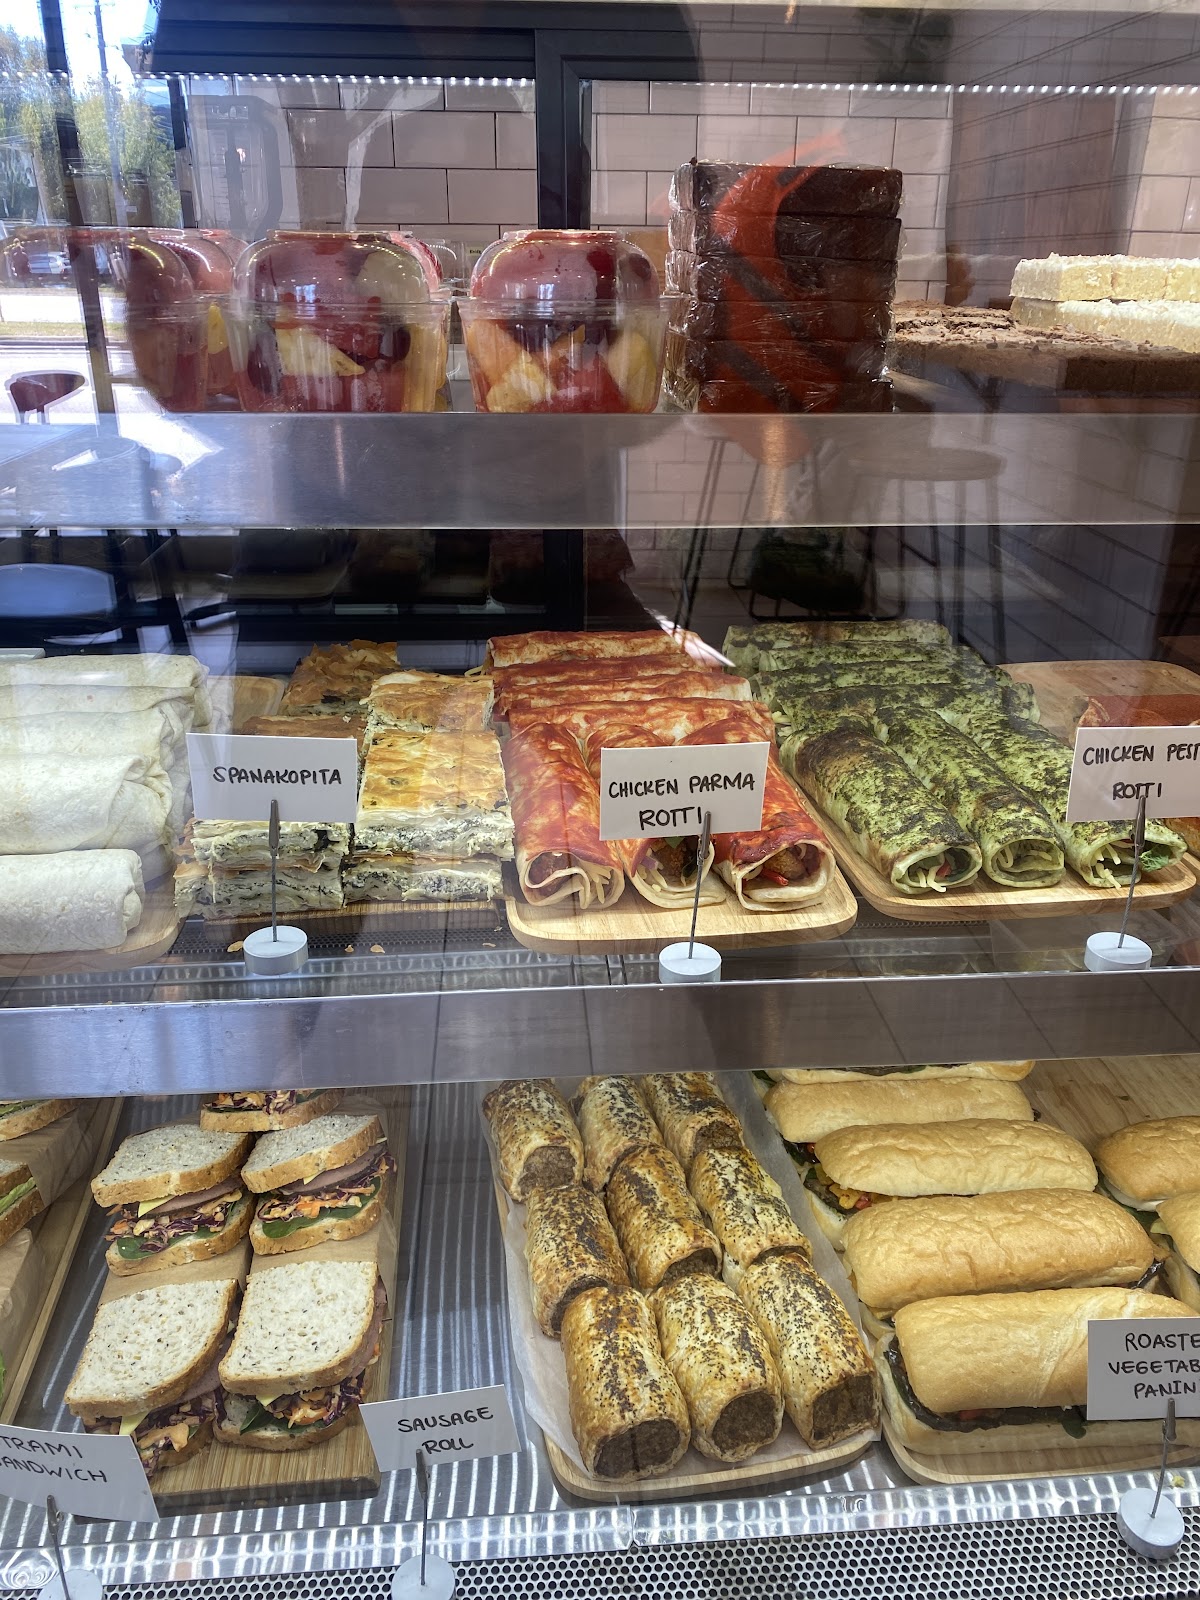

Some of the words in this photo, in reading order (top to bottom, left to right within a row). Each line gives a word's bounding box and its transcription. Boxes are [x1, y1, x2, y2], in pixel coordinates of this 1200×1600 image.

[1082, 746, 1154, 765] CHICKEN
[213, 766, 342, 785] SPANAKOPITA
[608, 778, 679, 798] CHICKEN
[689, 771, 755, 793] PARMA
[1112, 781, 1162, 800] ROTTI
[638, 806, 702, 830] ROTTI
[1125, 1332, 1200, 1352] ROASTE
[1108, 1359, 1200, 1375] VEGETAB
[1134, 1380, 1200, 1399] PANIN
[397, 1406, 494, 1433] SAUSAGE
[0, 1435, 83, 1459] TRAMI
[421, 1437, 474, 1454] ROLL
[0, 1456, 108, 1483] ANDWICH
